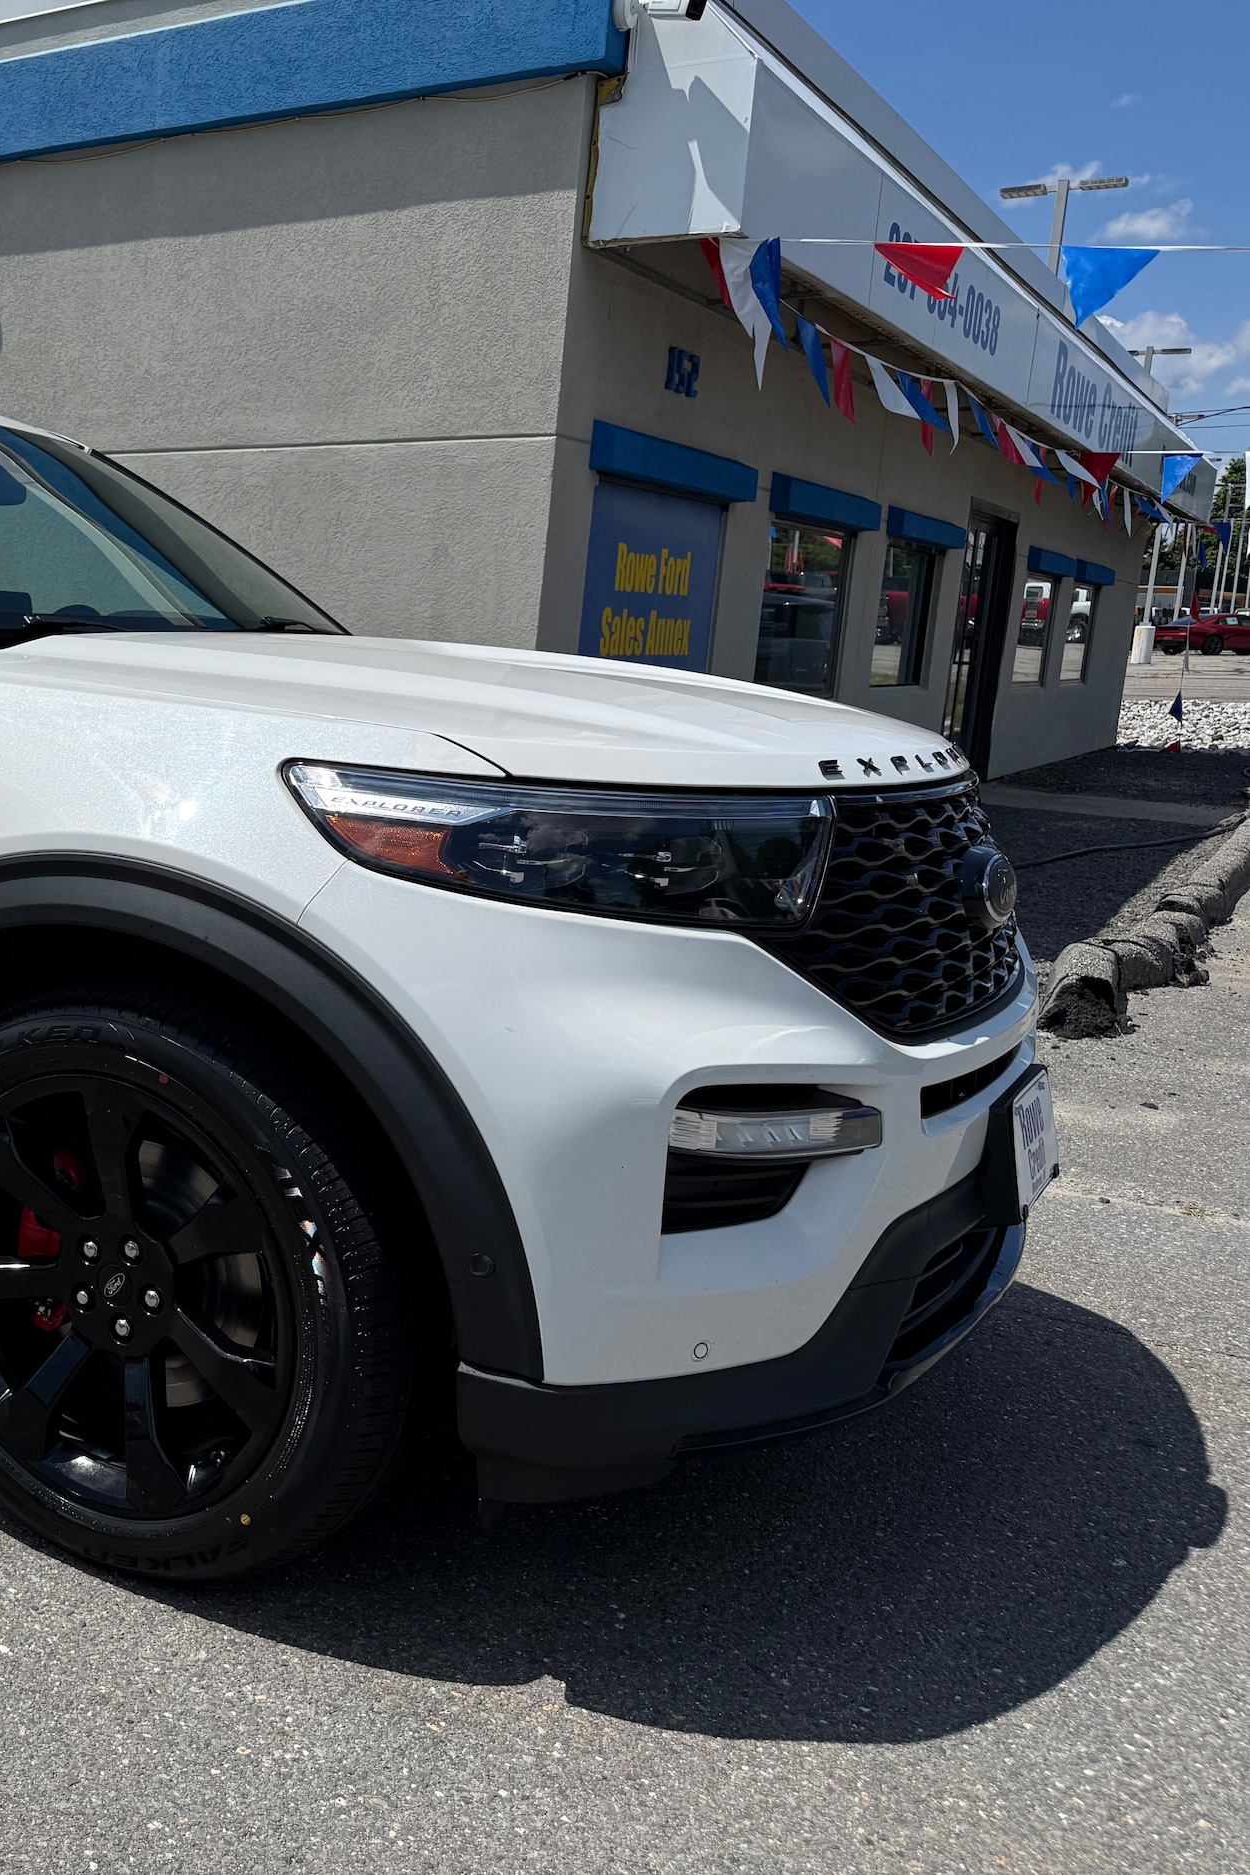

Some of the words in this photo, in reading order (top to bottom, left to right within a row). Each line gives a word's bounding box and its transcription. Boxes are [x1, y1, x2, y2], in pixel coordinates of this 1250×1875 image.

[664, 346, 700, 398] 152
[1051, 339, 1098, 440] Rowe
[1098, 382, 1139, 468] Credit
[614, 542, 657, 594] Rowe
[658, 548, 692, 596] Ford
[599, 606, 646, 657] Sales
[645, 610, 692, 656] Annex
[818, 743, 965, 779] EXPLOR
[331, 796, 463, 818] EXPLORER
[1018, 1096, 1045, 1151] Rowe
[1027, 1137, 1047, 1181] Credit
[106, 1276, 121, 1295] Ford
